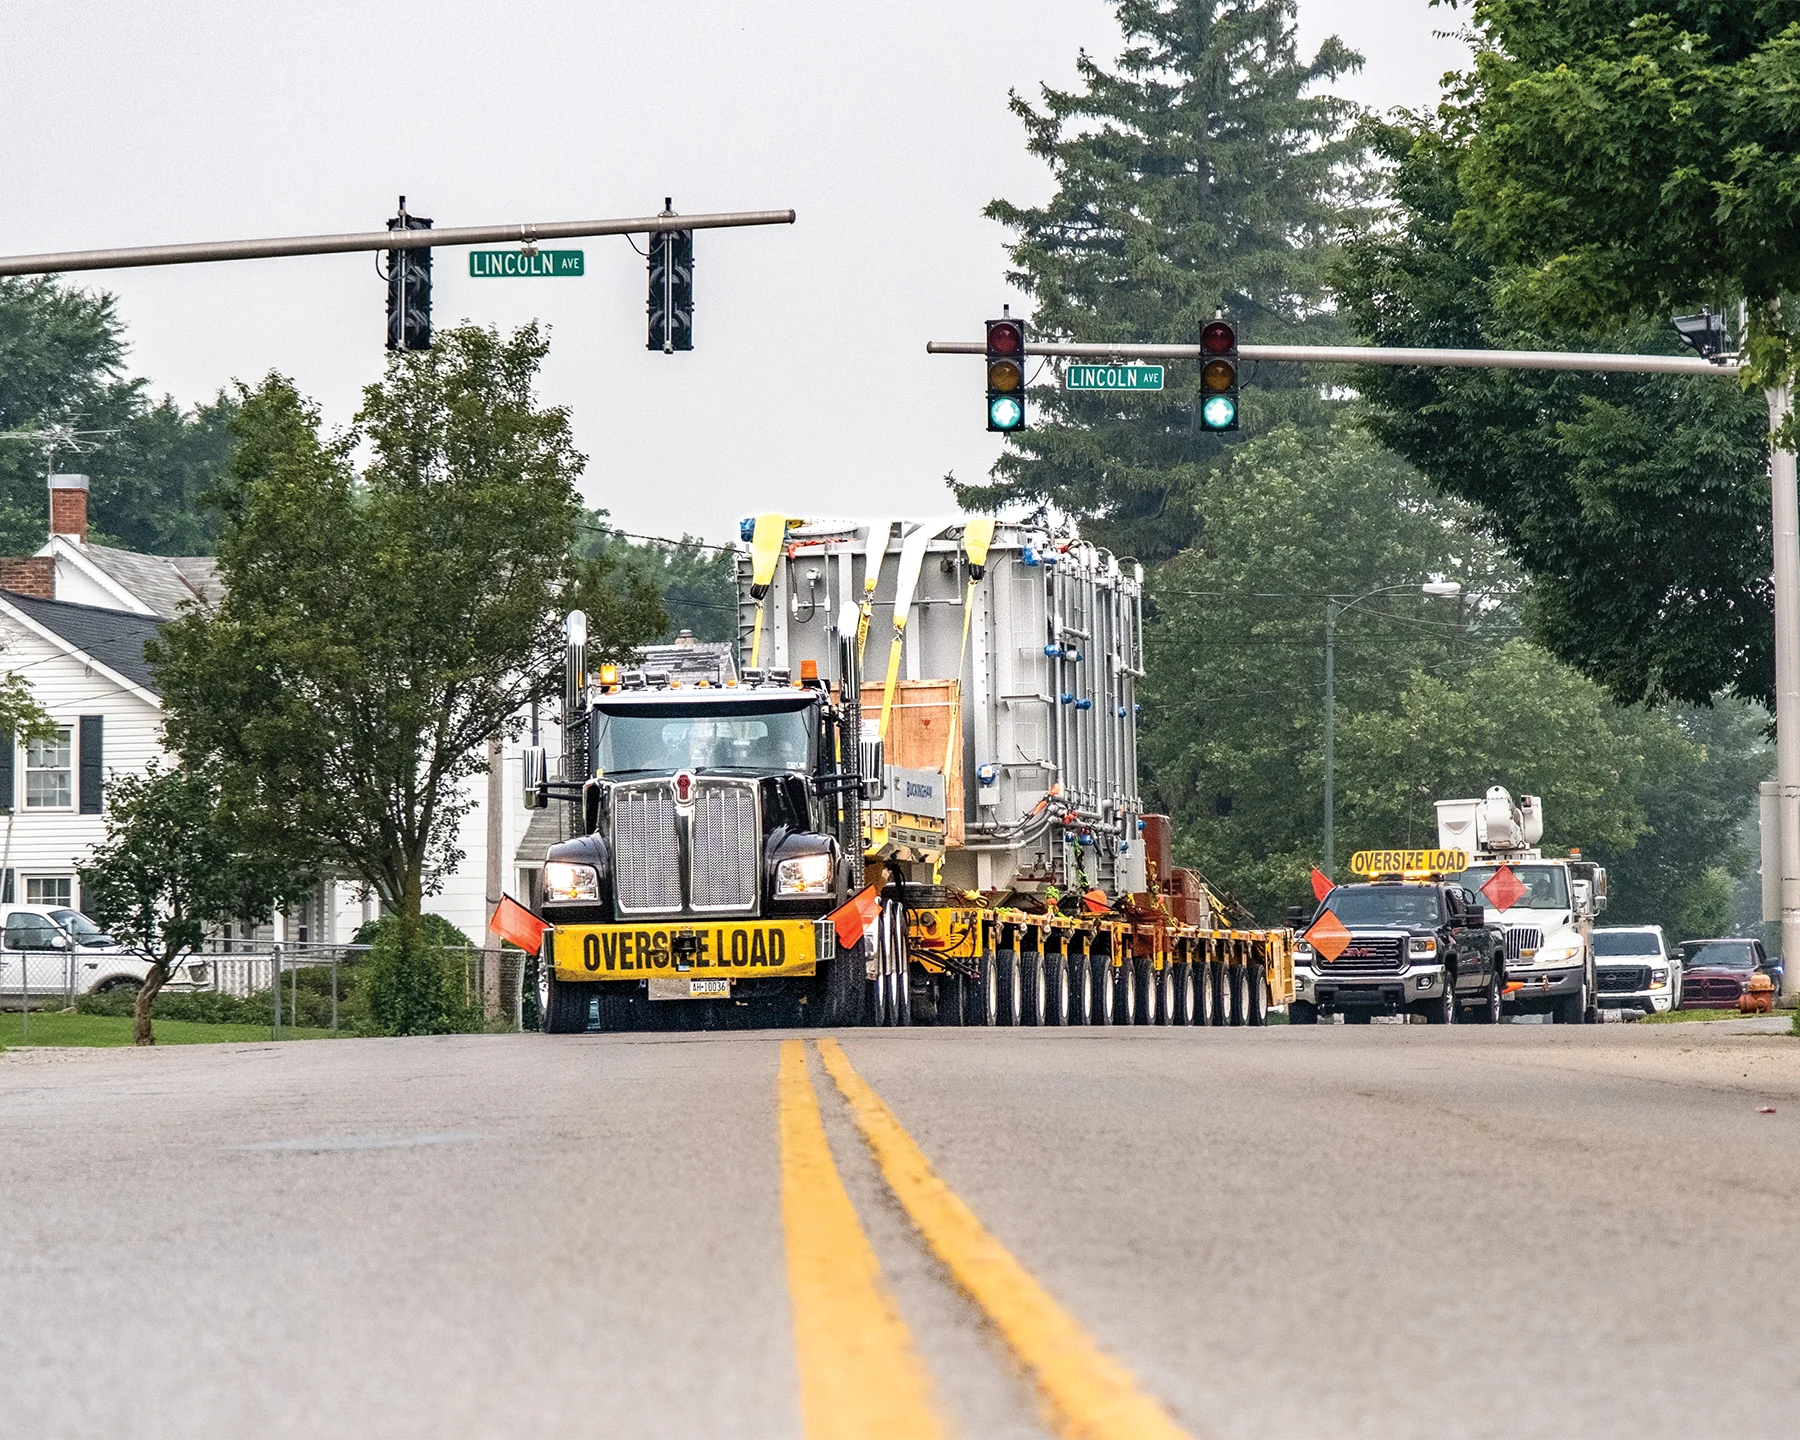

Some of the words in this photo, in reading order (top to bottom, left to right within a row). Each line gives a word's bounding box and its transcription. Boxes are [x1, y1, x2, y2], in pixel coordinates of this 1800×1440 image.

[474, 253, 554, 275] LINCOLN
[561, 258, 580, 269] AVE
[1070, 368, 1137, 387] LINCOLN
[1143, 373, 1158, 383] AVE
[1355, 851, 1424, 872] OVERSIZE
[1428, 851, 1465, 871] LOAD
[716, 928, 786, 968] LOAD
